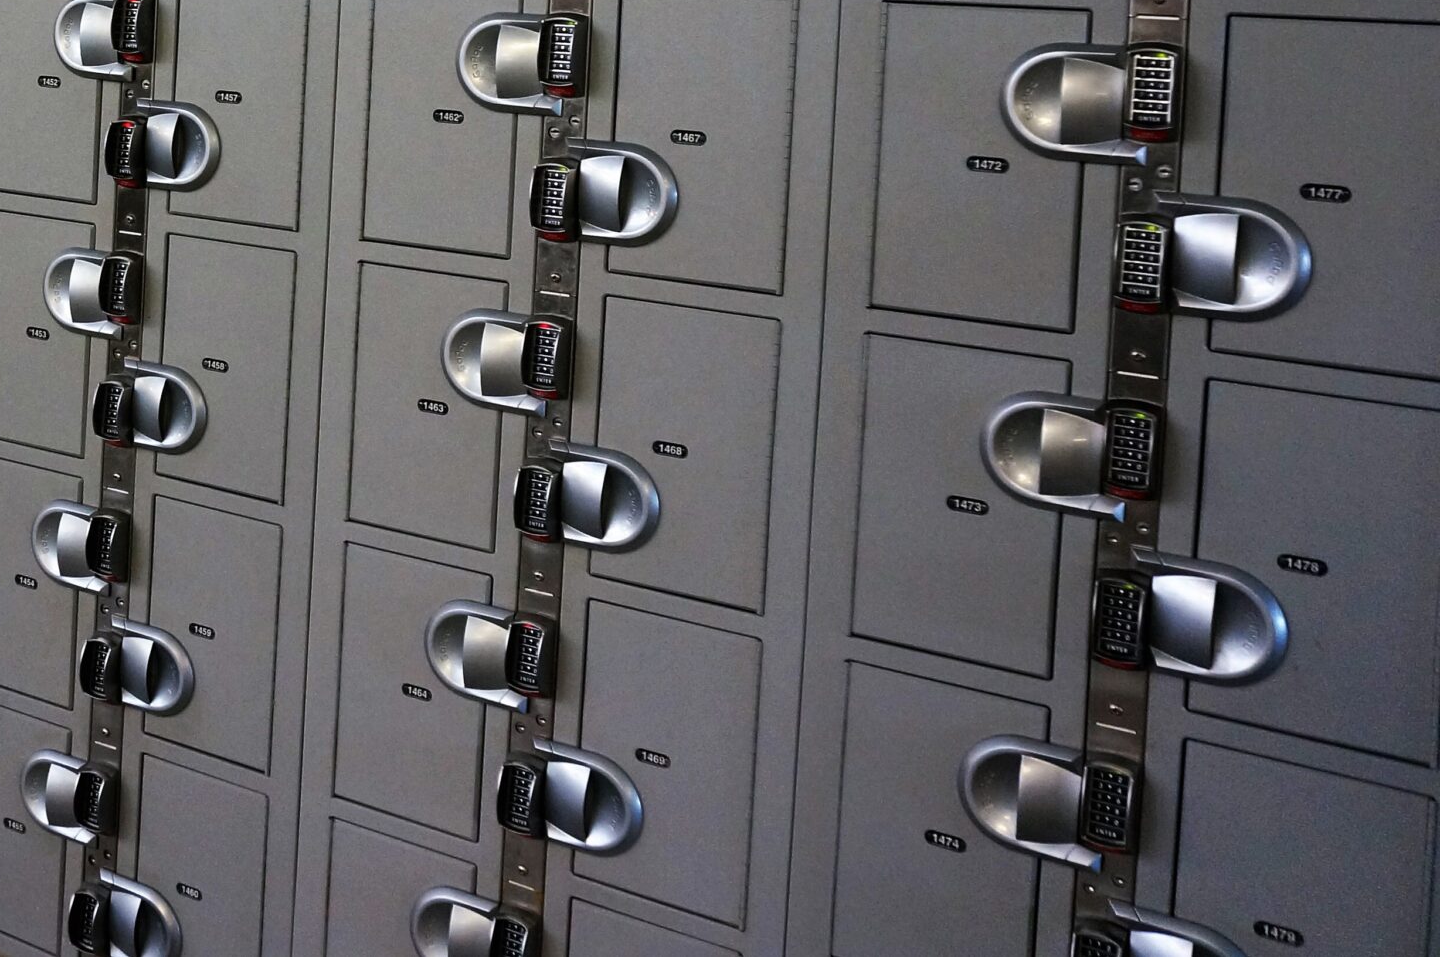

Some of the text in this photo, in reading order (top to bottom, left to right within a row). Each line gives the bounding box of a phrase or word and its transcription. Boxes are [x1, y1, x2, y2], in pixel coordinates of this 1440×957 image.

[439, 112, 459, 122] 1462
[678, 133, 701, 143] 1467
[974, 159, 1002, 171] 1472
[1310, 187, 1343, 200] 1477
[659, 444, 682, 455] 1468
[954, 499, 982, 511] 1473
[1287, 558, 1319, 573] 1478
[642, 752, 666, 765] 1469
[932, 834, 959, 849] 1474
[1264, 925, 1296, 943] 1479
